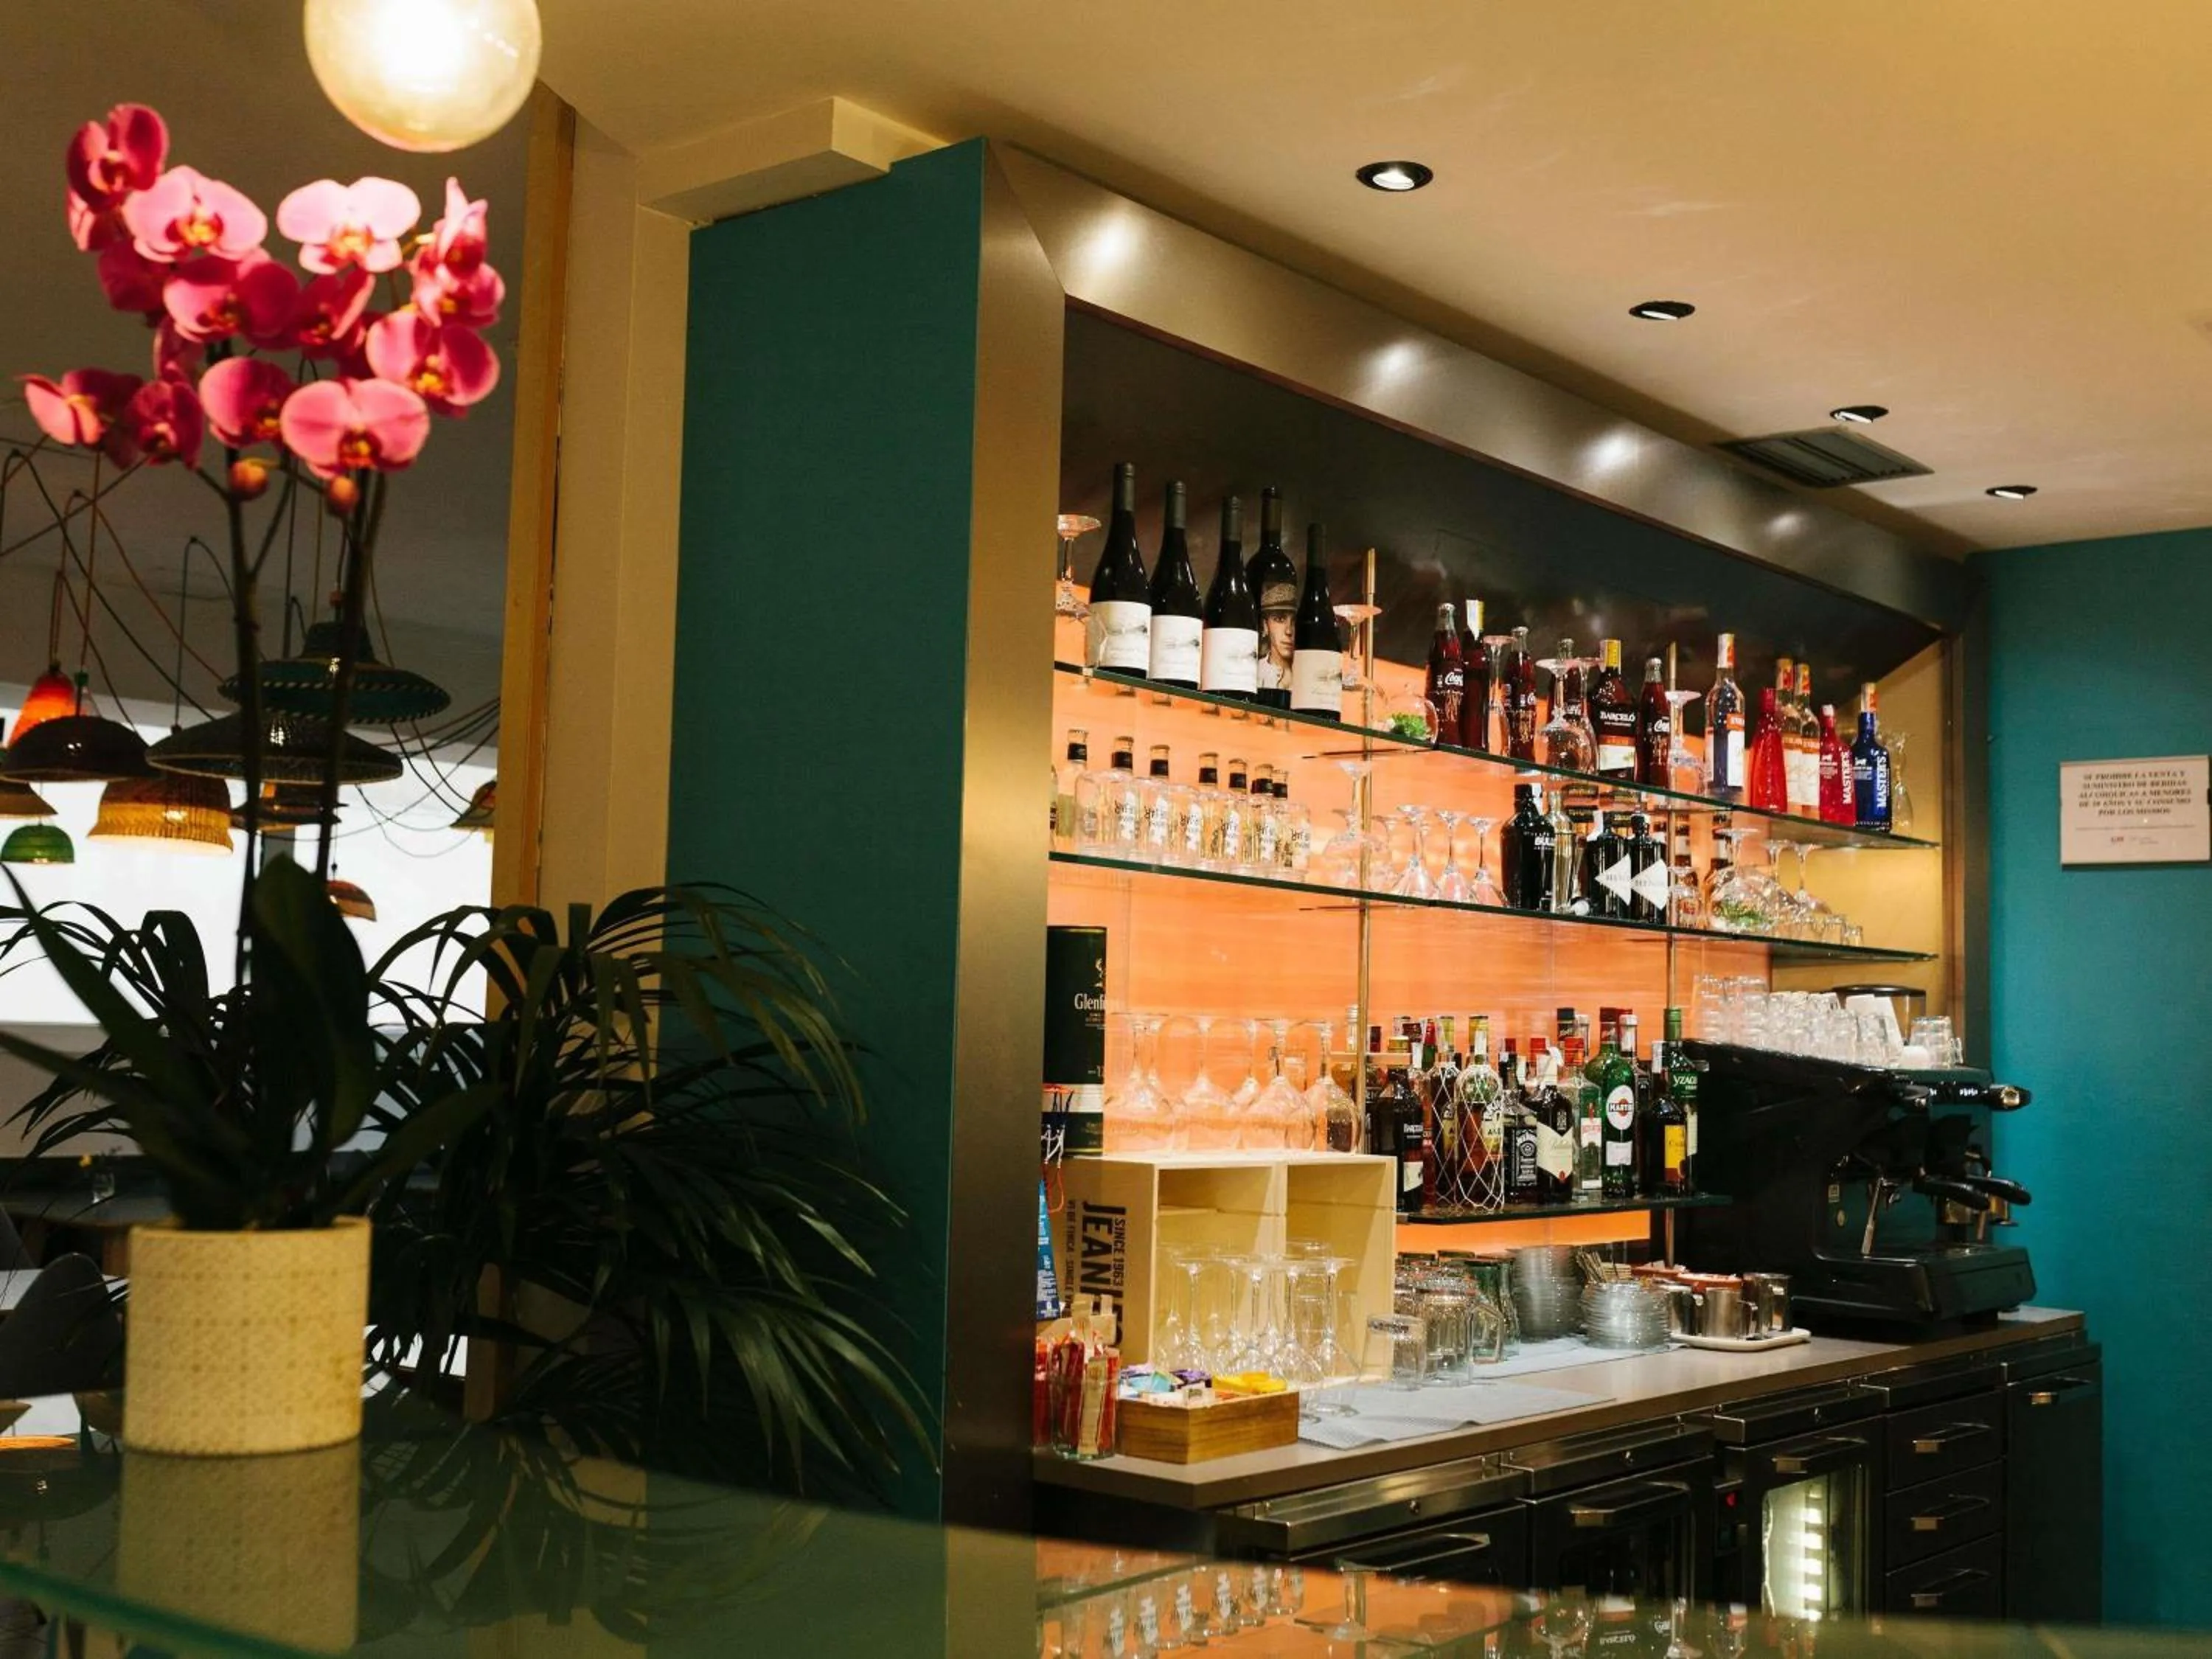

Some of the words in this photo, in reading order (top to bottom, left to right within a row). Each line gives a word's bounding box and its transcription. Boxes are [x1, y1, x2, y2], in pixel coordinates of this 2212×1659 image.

[1599, 711, 1636, 723] BARCELÓ
[1113, 1217, 1125, 1253] SINCE
[1112, 1258, 1124, 1287] 1963
